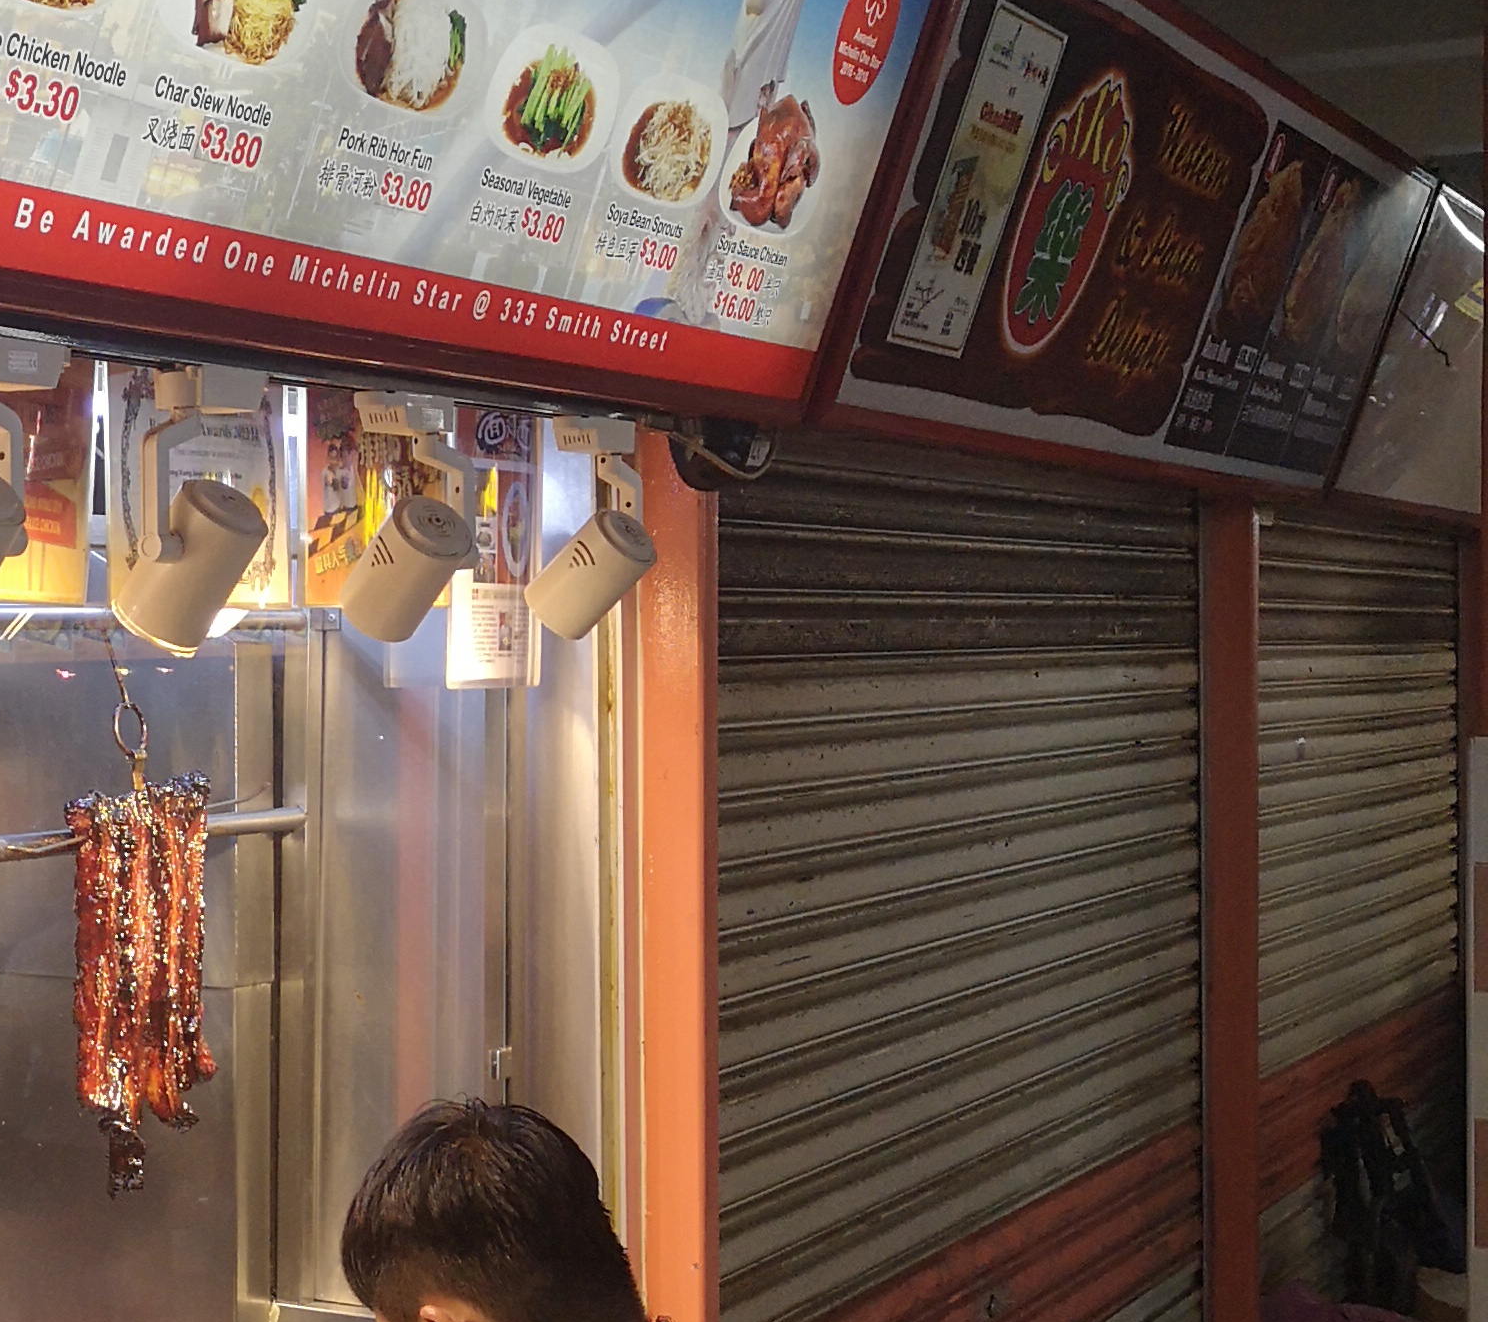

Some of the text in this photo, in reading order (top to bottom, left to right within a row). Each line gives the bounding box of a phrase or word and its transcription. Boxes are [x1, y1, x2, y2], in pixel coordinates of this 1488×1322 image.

[6, 33, 70, 71] Chicken
[72, 51, 127, 87] Noodle
[5, 68, 79, 121] $3.30
[155, 75, 272, 127] Char Siew Noodle
[142, 118, 262, 168] 叉烧面 $3.80
[338, 127, 433, 171] Pork Rib Hor Fun
[319, 159, 432, 211] 排骨河粉 $3.80
[481, 167, 572, 208] Seasonal Vegetable
[521, 206, 565, 243] $3.80
[607, 203, 683, 239] Soya Bean Sprouts
[639, 237, 678, 271] $3.00
[718, 235, 788, 267] Soya Sauce Chicken
[15, 198, 54, 233] Be
[72, 210, 209, 264] Awarded
[224, 241, 275, 276] One
[289, 254, 402, 301] Michelin
[413, 279, 463, 312] Star
[472, 289, 491, 321] @
[500, 297, 538, 326] 335
[545, 307, 602, 339] Smith
[610, 320, 669, 352] Street
[714, 291, 755, 322] $16.00
